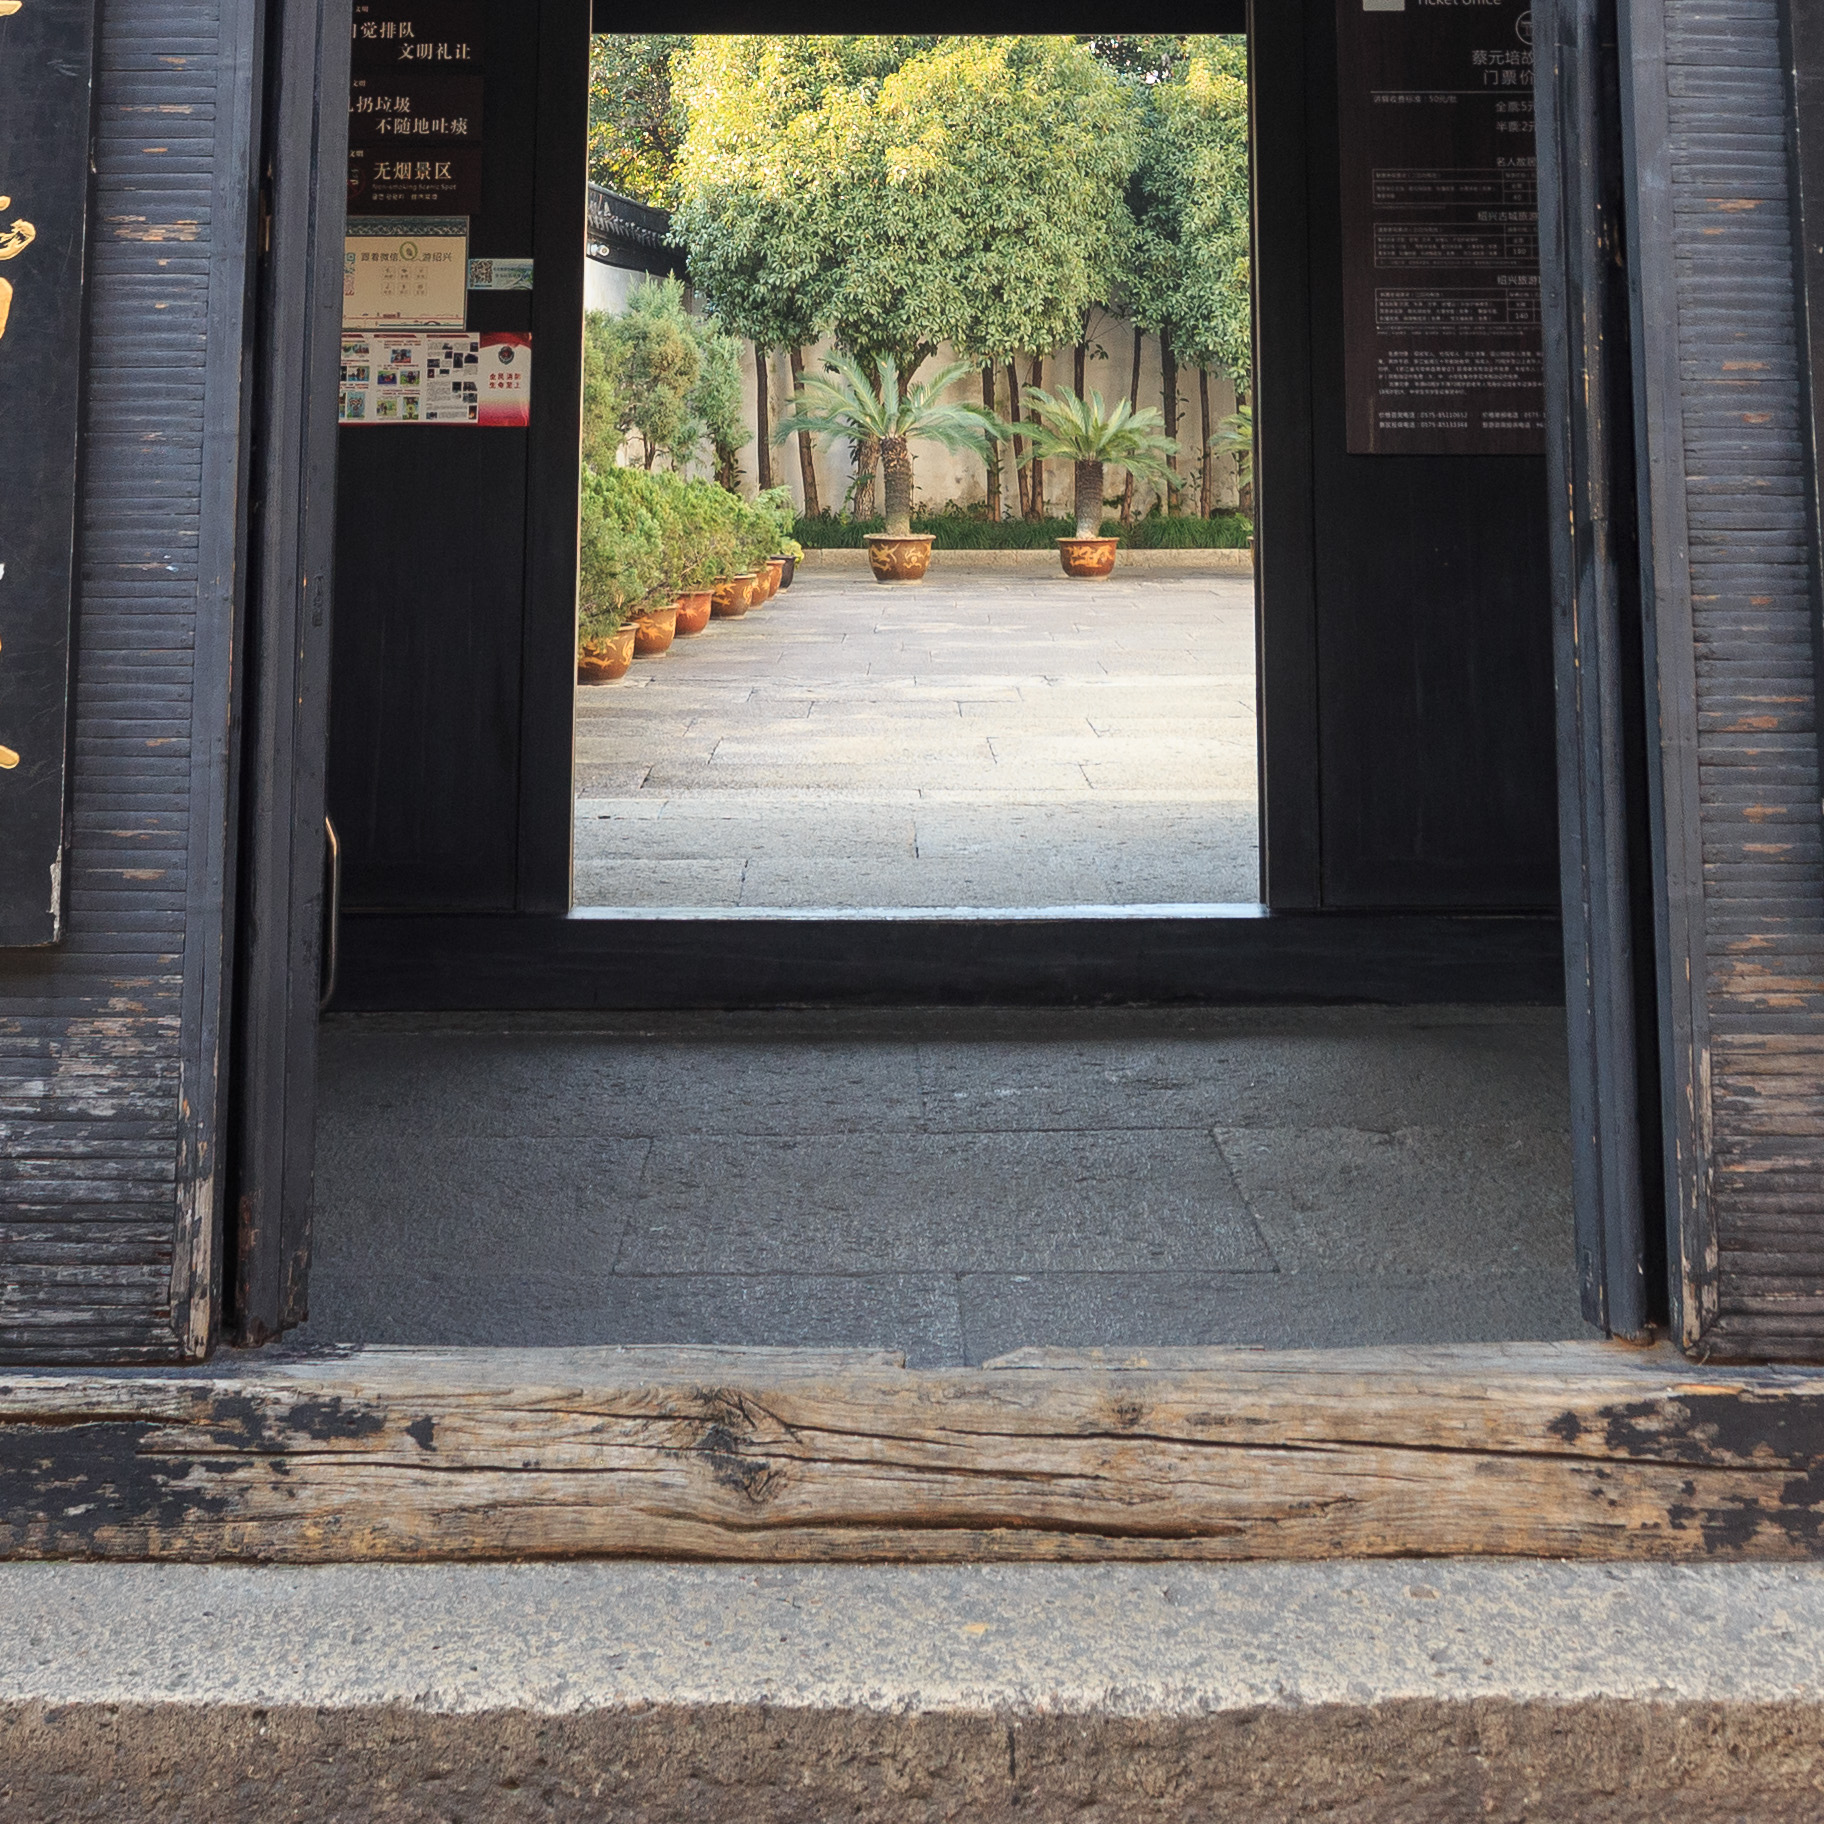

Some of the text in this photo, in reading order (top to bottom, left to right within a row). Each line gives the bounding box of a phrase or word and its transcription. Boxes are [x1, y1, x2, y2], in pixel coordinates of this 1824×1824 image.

[398, 43, 471, 60] 文明礼让
[348, 96, 411, 113] 扔垃圾
[376, 118, 468, 135] 不随地吐痰
[373, 162, 451, 180] 无烟景区
